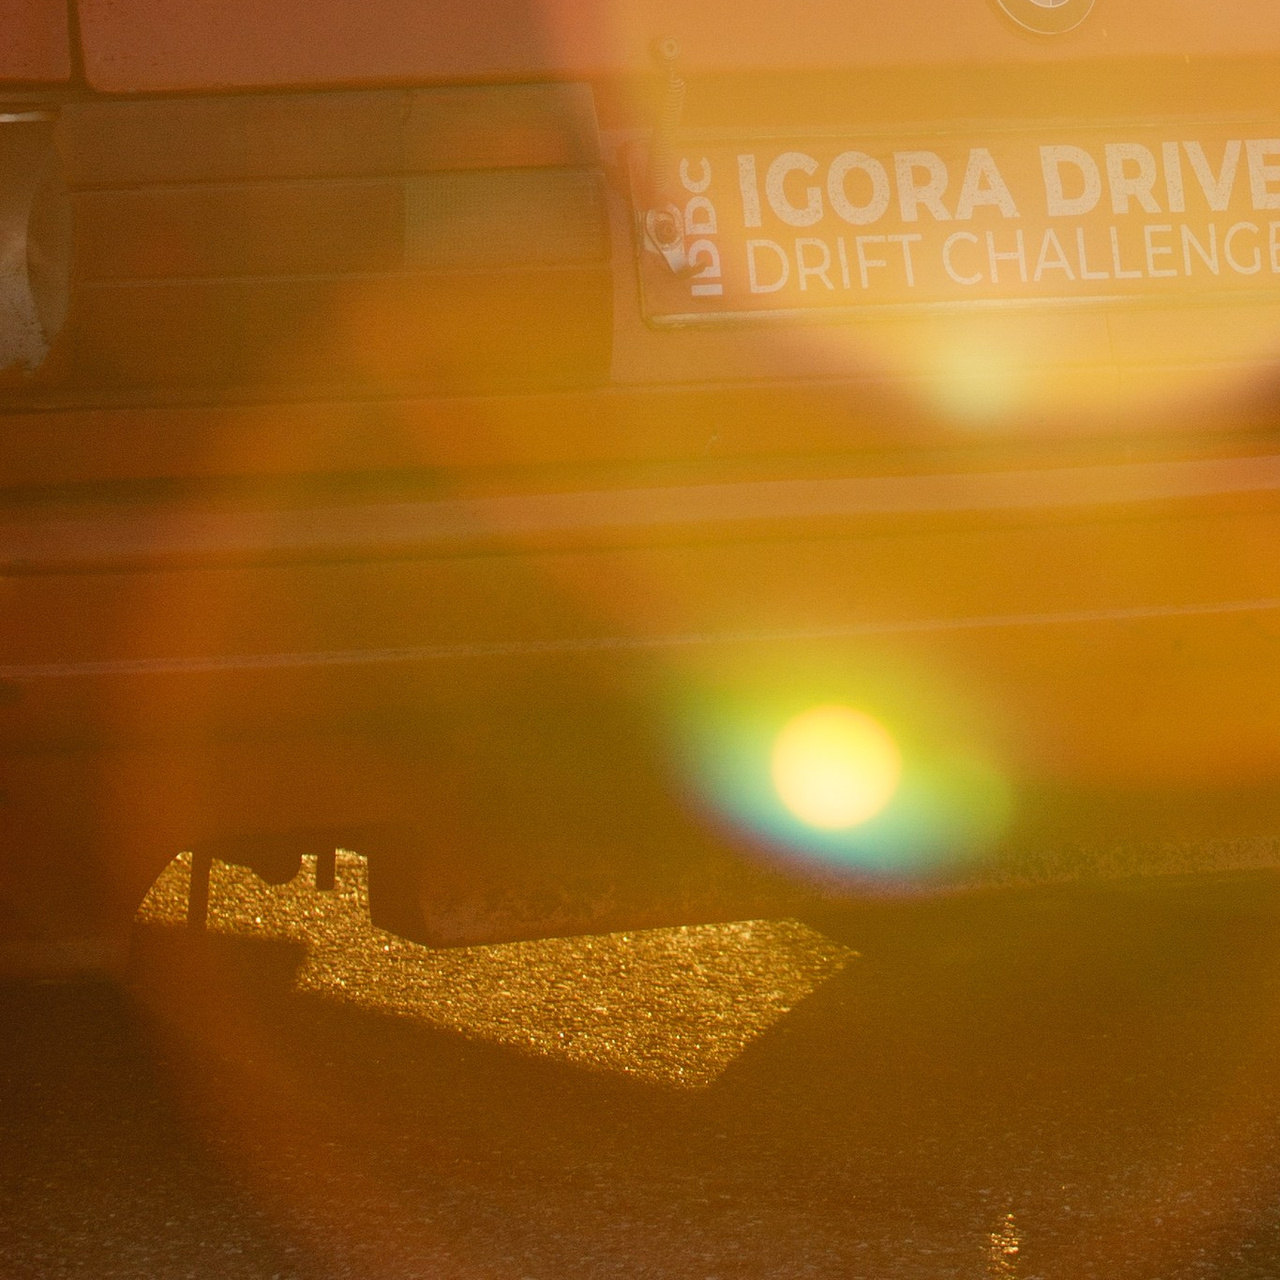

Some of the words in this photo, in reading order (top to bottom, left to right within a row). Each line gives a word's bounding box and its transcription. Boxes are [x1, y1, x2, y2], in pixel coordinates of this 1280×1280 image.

[679, 156, 723, 297] IDDC
[737, 147, 1020, 228] IGORA
[746, 233, 923, 295] DRIFT
